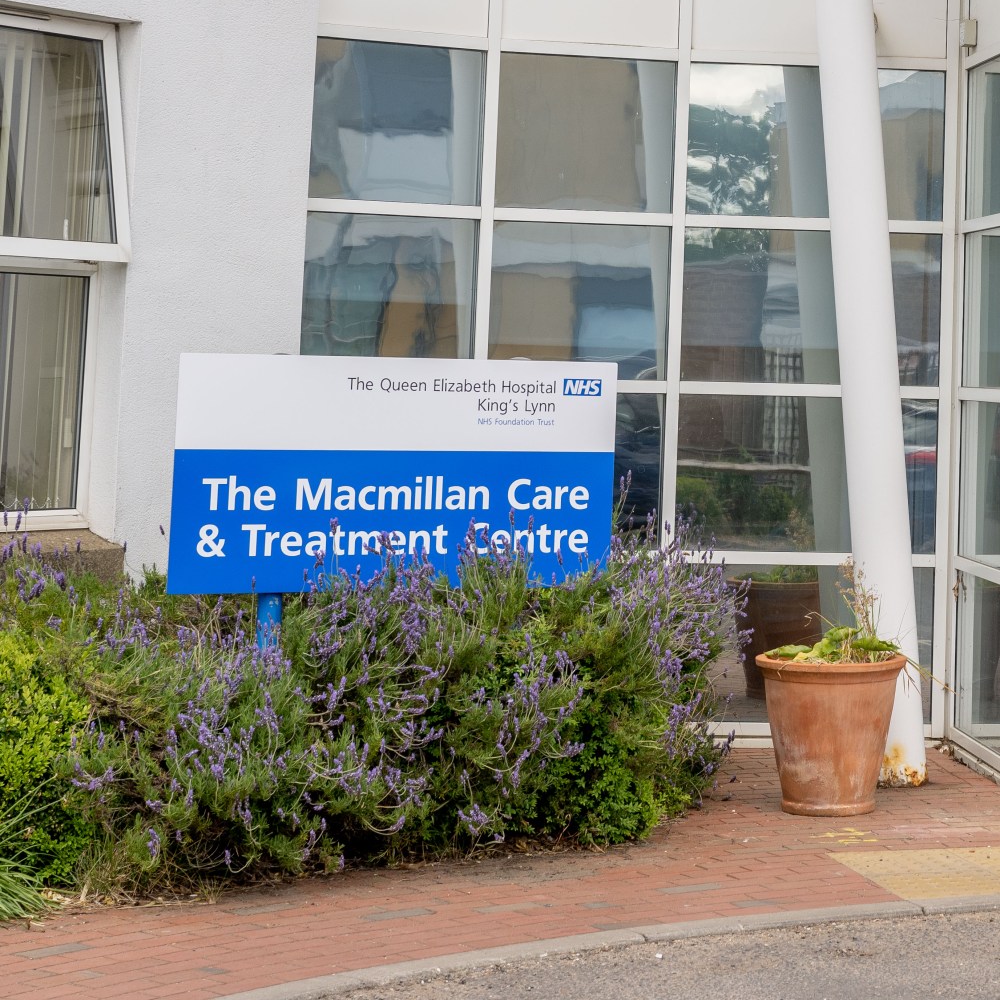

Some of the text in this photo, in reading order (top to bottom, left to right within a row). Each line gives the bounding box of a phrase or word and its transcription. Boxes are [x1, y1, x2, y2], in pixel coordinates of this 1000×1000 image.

[347, 377, 557, 396] The Queen Elizabeth Hospital
[564, 379, 601, 396] NHS
[477, 398, 556, 415] King's Lynn
[477, 418, 555, 426] NHS Foundation Trust
[202, 475, 590, 511] The Macmillan Care
[196, 522, 589, 558] & Treatment Centre
